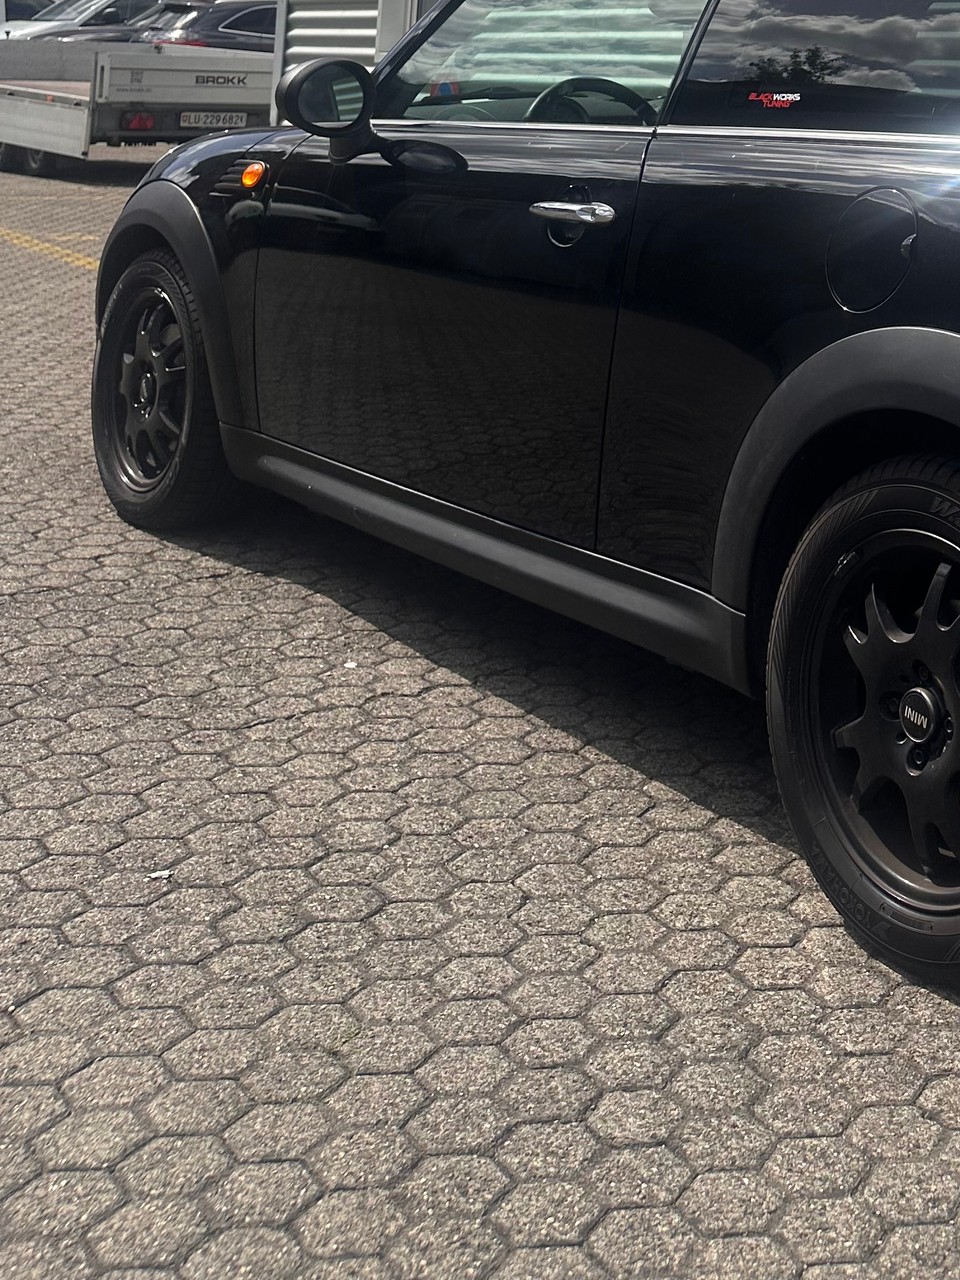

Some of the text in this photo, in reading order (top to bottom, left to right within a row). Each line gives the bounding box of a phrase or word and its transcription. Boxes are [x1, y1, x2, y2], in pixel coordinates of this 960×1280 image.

[195, 75, 247, 86] BROKK
[763, 100, 790, 108] TUNING
[903, 705, 928, 729] MINI
